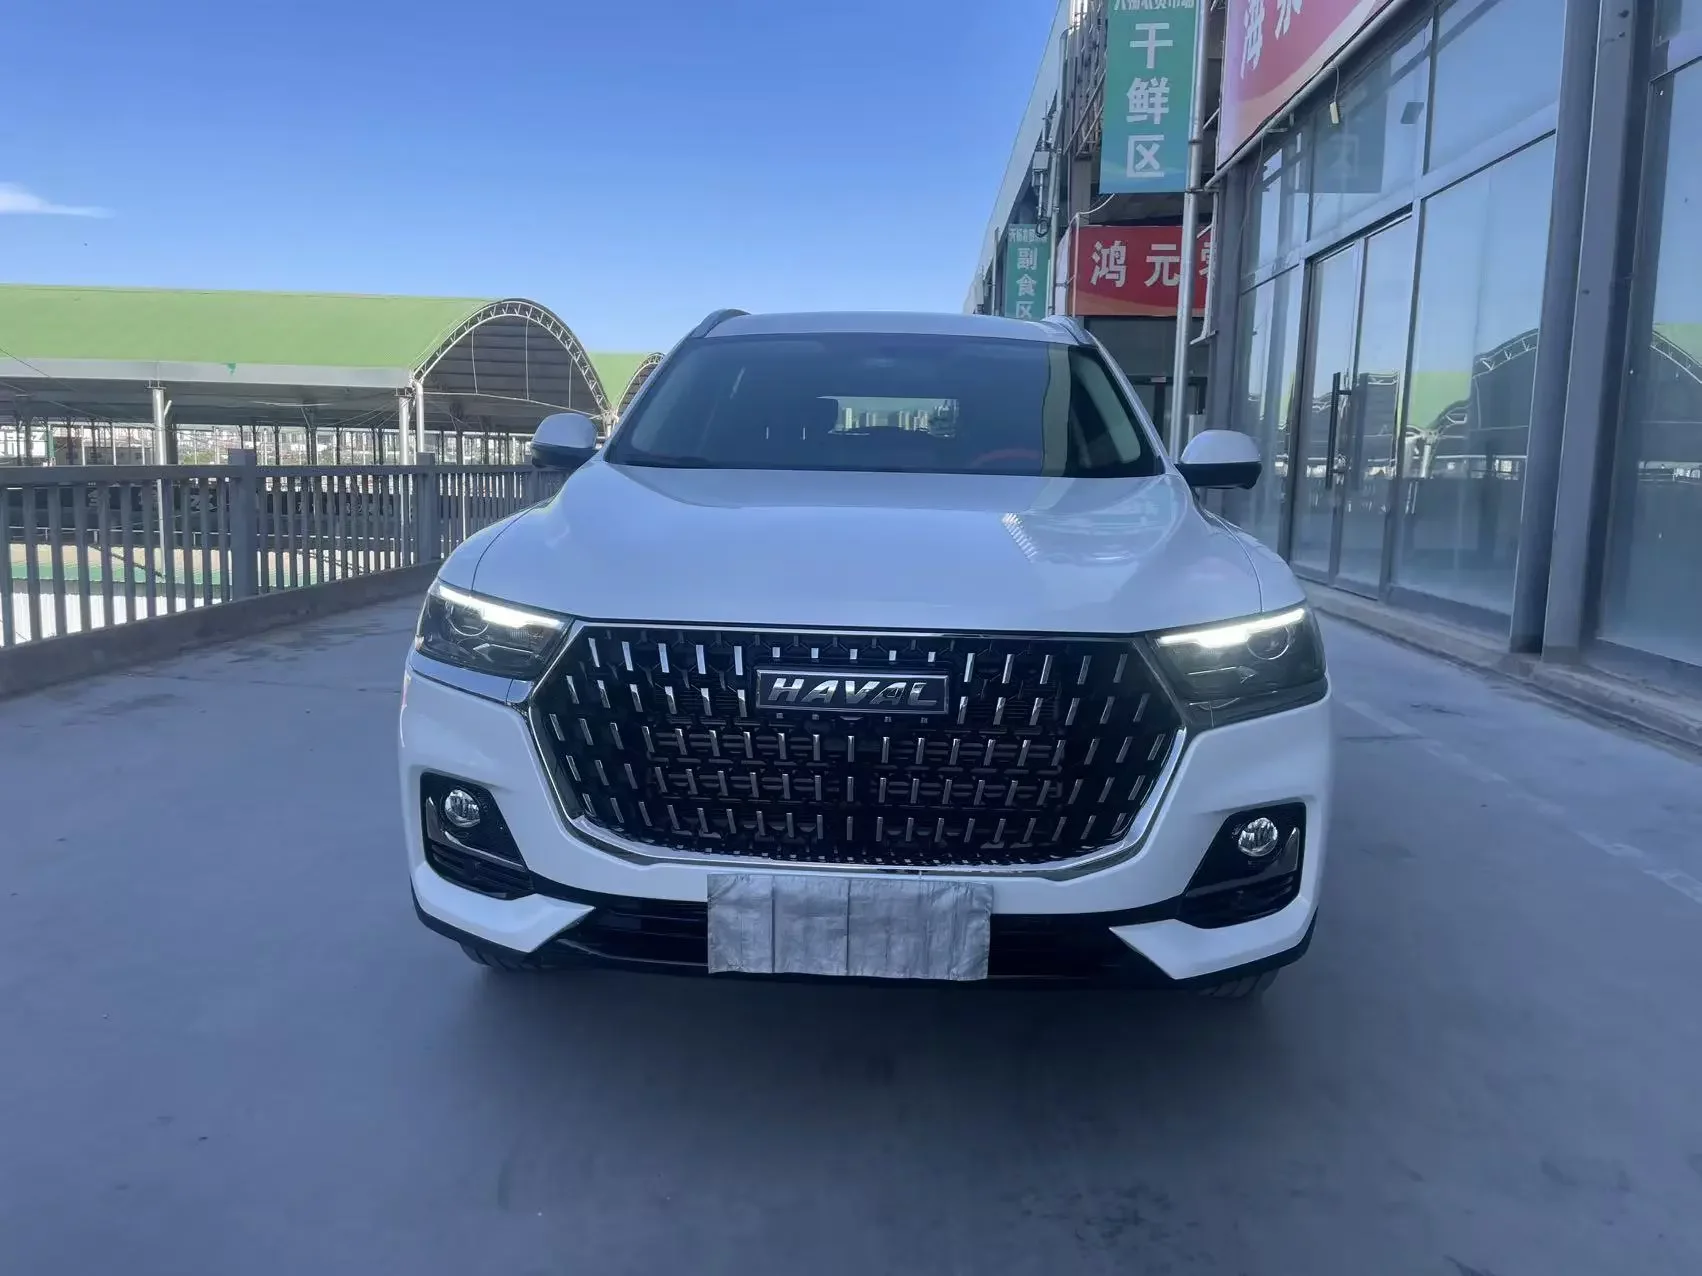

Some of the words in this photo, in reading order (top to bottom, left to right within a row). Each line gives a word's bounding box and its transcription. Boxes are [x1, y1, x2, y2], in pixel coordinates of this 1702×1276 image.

[1126, 22, 1173, 178] 干鲜区
[768, 677, 937, 705] HAVAL
